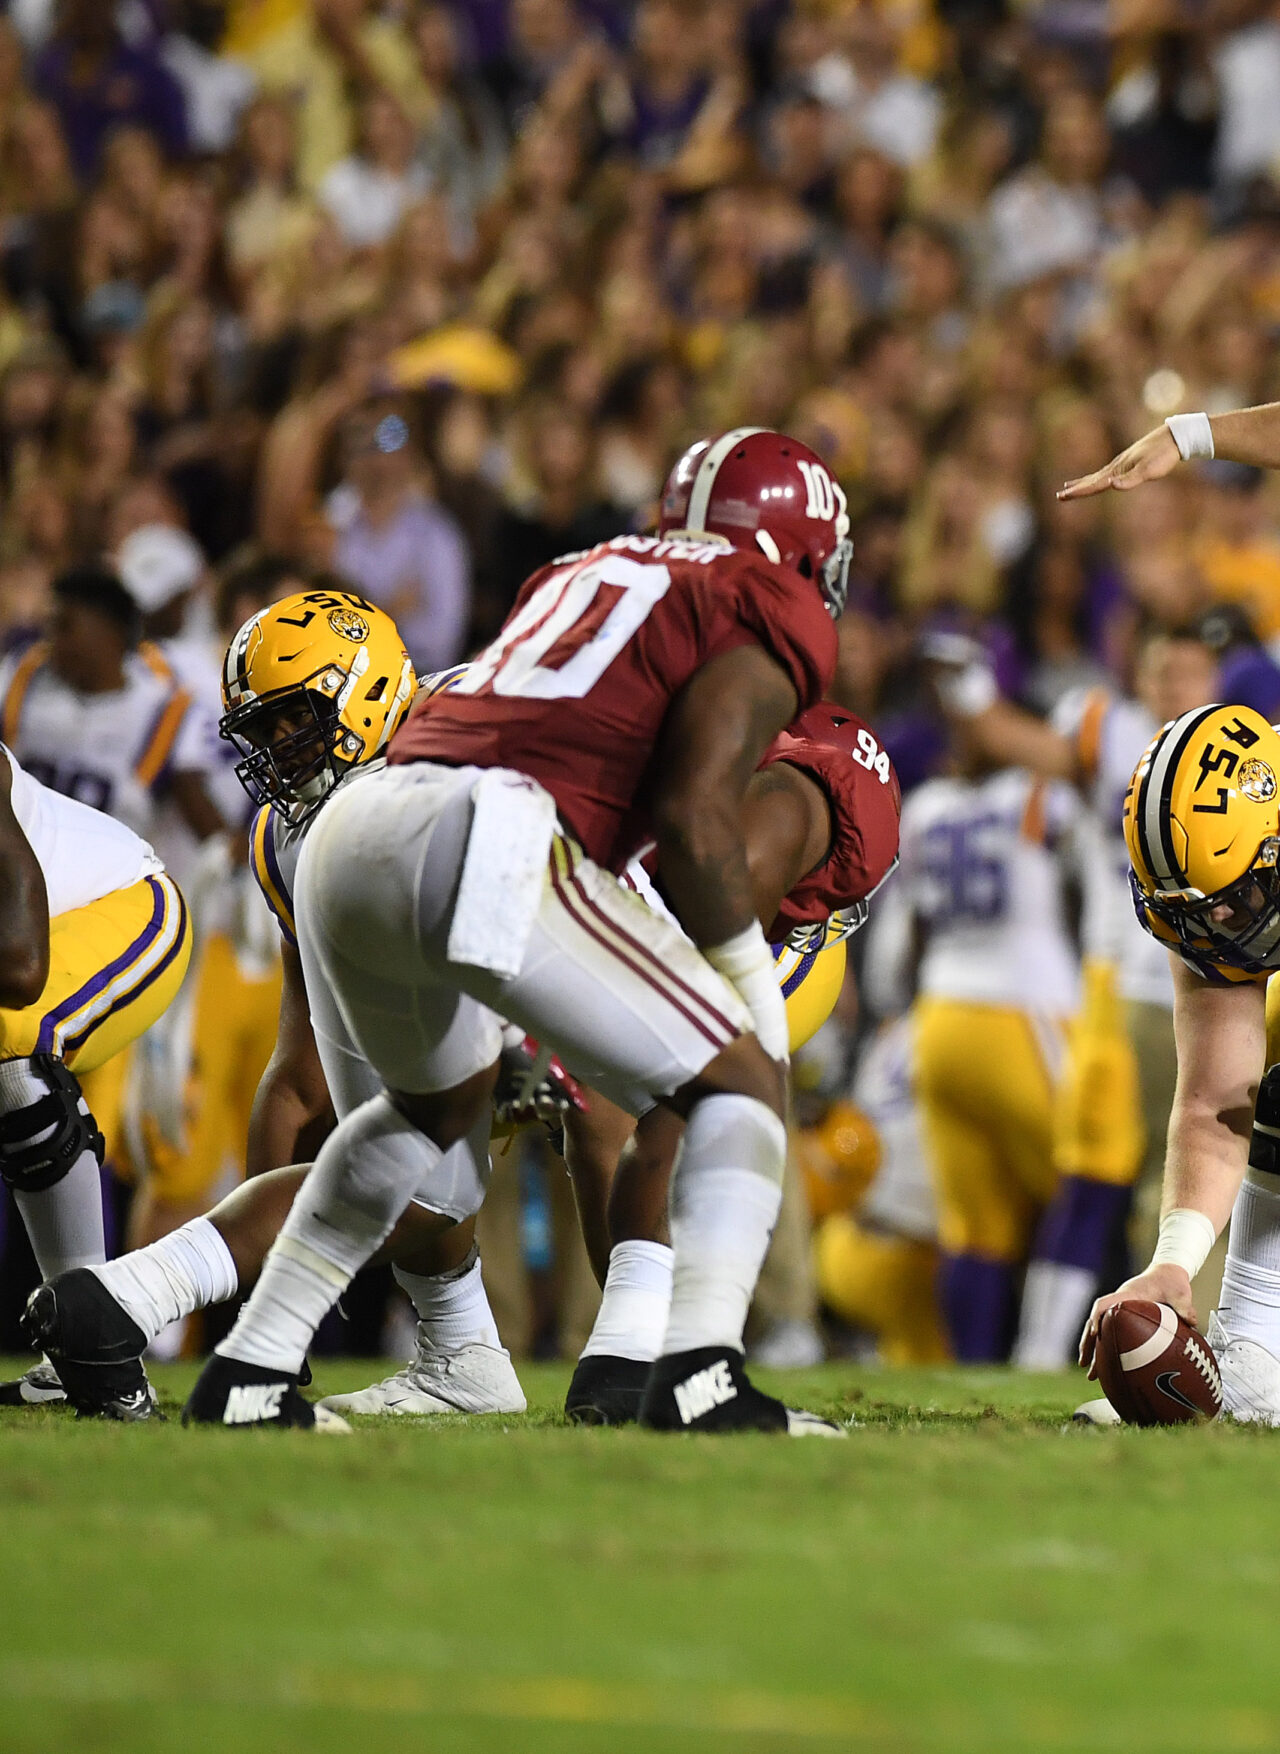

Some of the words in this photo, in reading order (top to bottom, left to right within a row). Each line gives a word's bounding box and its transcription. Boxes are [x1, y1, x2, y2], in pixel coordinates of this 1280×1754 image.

[797, 460, 835, 521] 10
[276, 592, 375, 628] LSU
[448, 554, 671, 699] 10
[852, 729, 890, 784] 94
[1193, 717, 1260, 815] LSU
[223, 1384, 289, 1424] NIKE
[673, 1359, 738, 1424] NIKE
